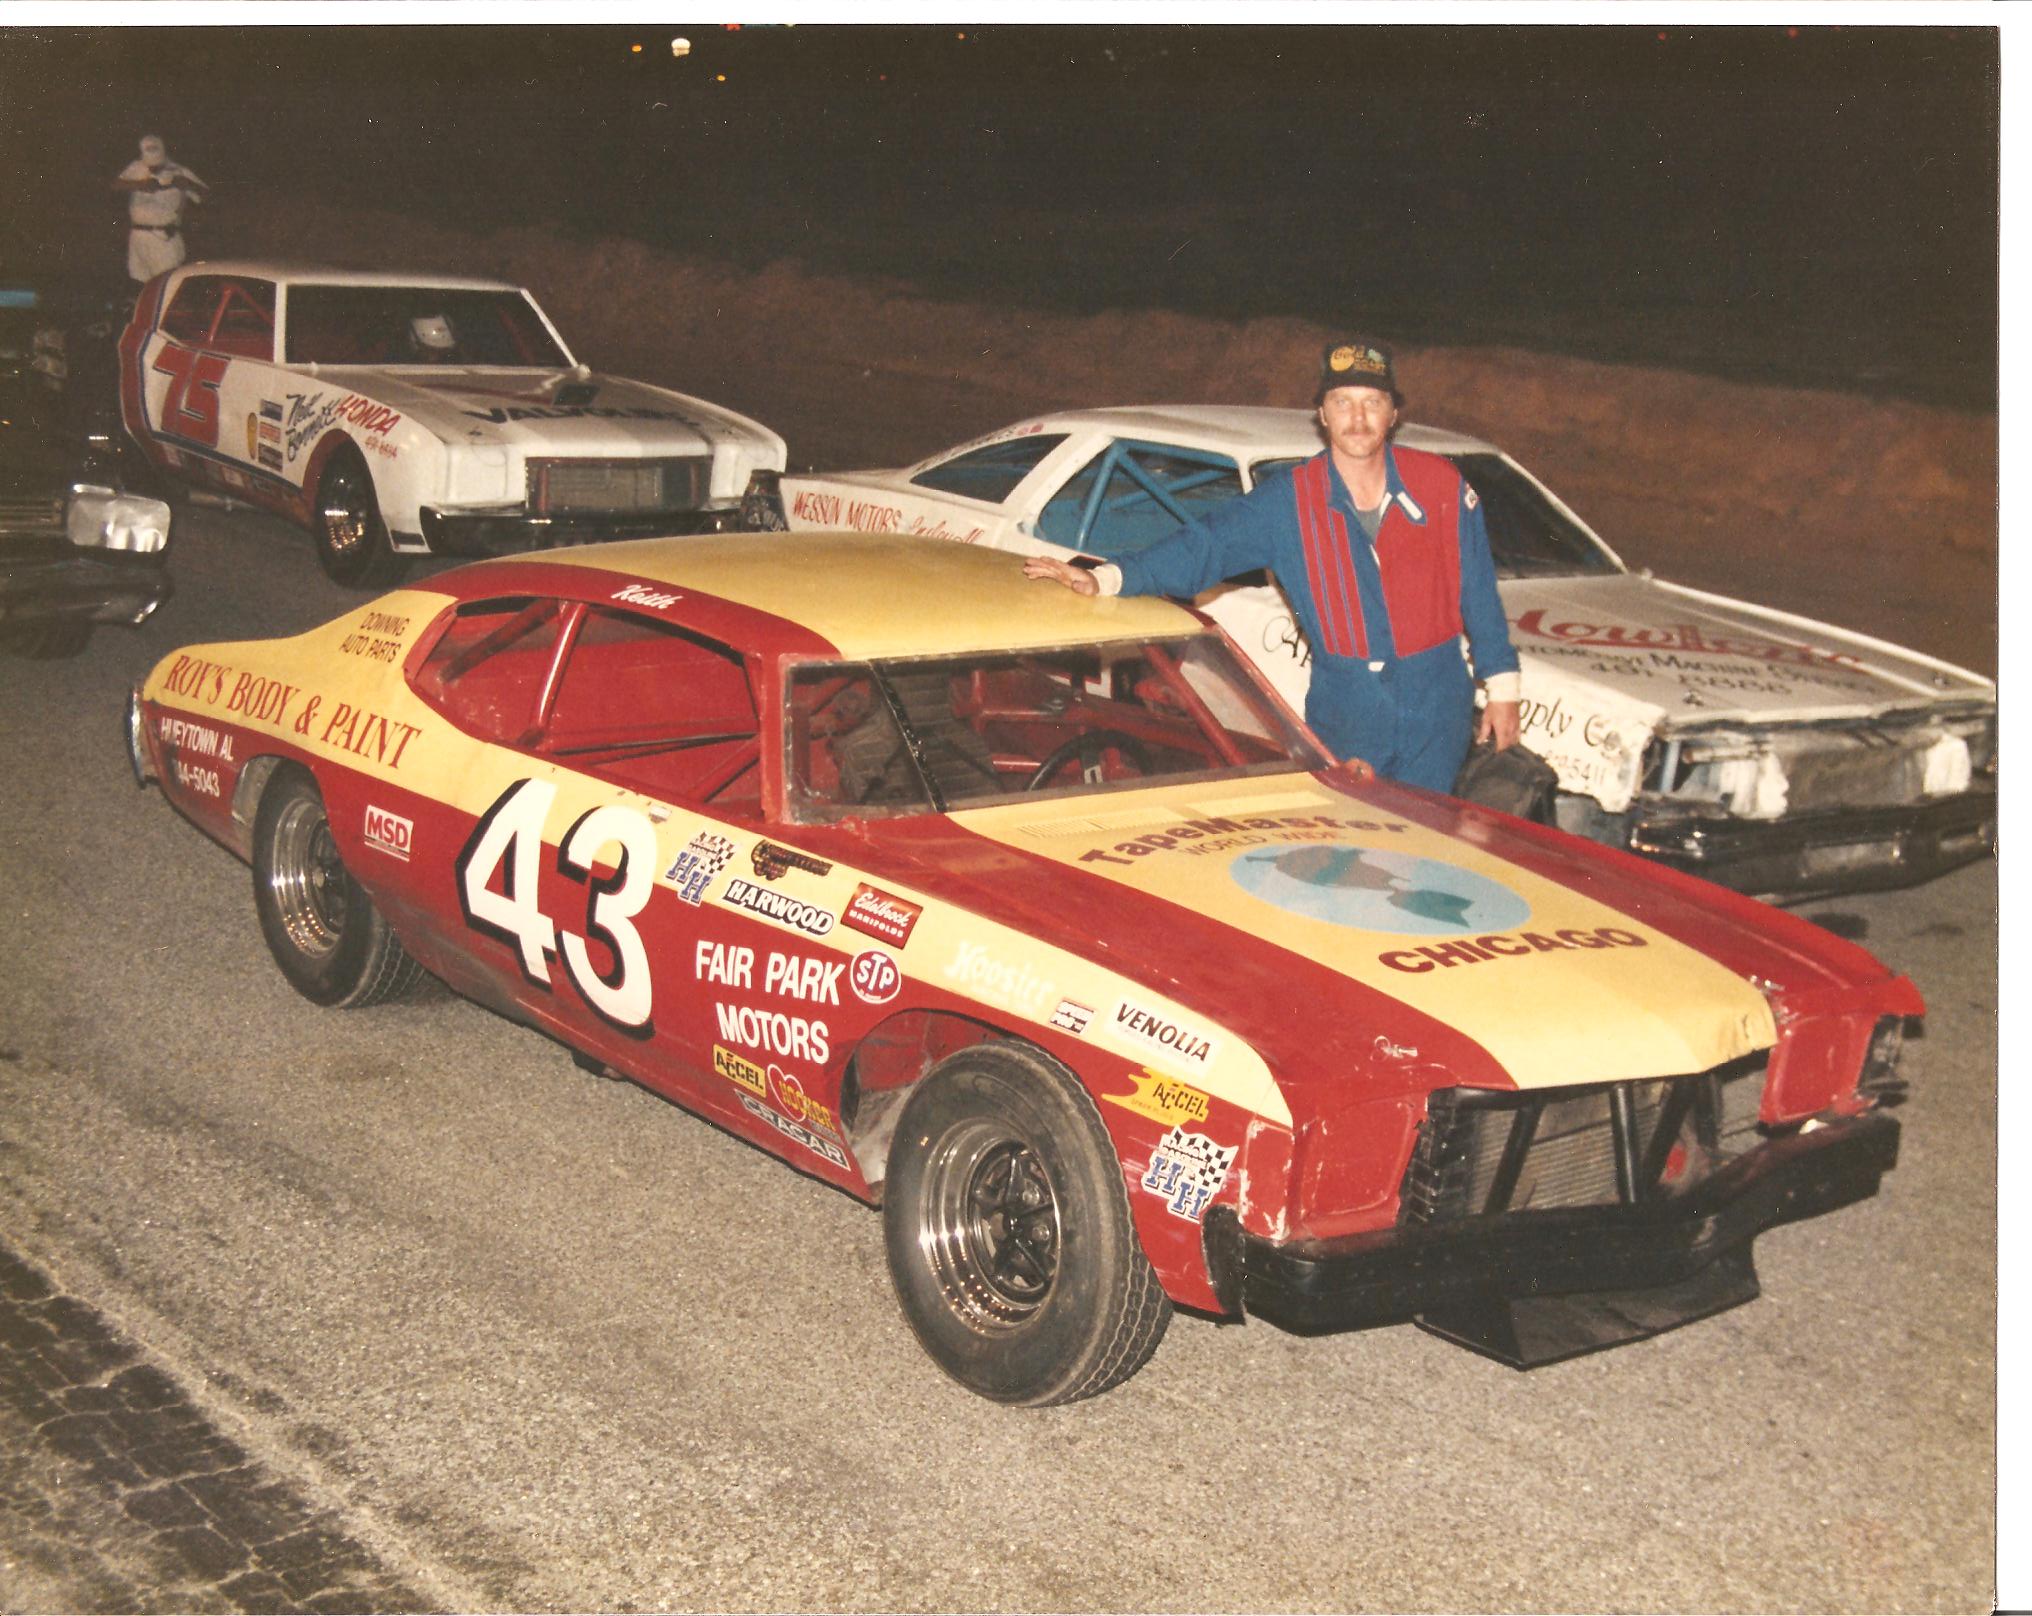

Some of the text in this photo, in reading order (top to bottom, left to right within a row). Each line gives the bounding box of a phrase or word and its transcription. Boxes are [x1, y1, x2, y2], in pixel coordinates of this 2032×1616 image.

[153, 342, 231, 448] 75
[334, 394, 401, 436] HONDA
[792, 490, 841, 525] WESSON
[847, 500, 903, 534] MOTORS
[610, 584, 684, 609] Keith
[360, 612, 410, 637] DOWNING
[339, 633, 401, 663] AUTO PARTS
[163, 655, 423, 770] ROY'S BODY & PAINT
[1518, 697, 1573, 738] pply
[366, 810, 409, 849] MSD
[1078, 814, 1408, 866] TapeMaster
[1183, 834, 1268, 857] WORLD
[458, 777, 656, 1038] 43
[726, 880, 834, 935] HARWOOD
[1378, 927, 1649, 974] CHICAGO
[695, 940, 846, 1006] FAIR PARK
[856, 953, 895, 992] STP
[715, 1002, 830, 1065] MOTORS
[1116, 1002, 1211, 1062] VENOLIA
[715, 1050, 765, 1092] ACCEL
[1152, 1081, 1204, 1119] ACCEL
